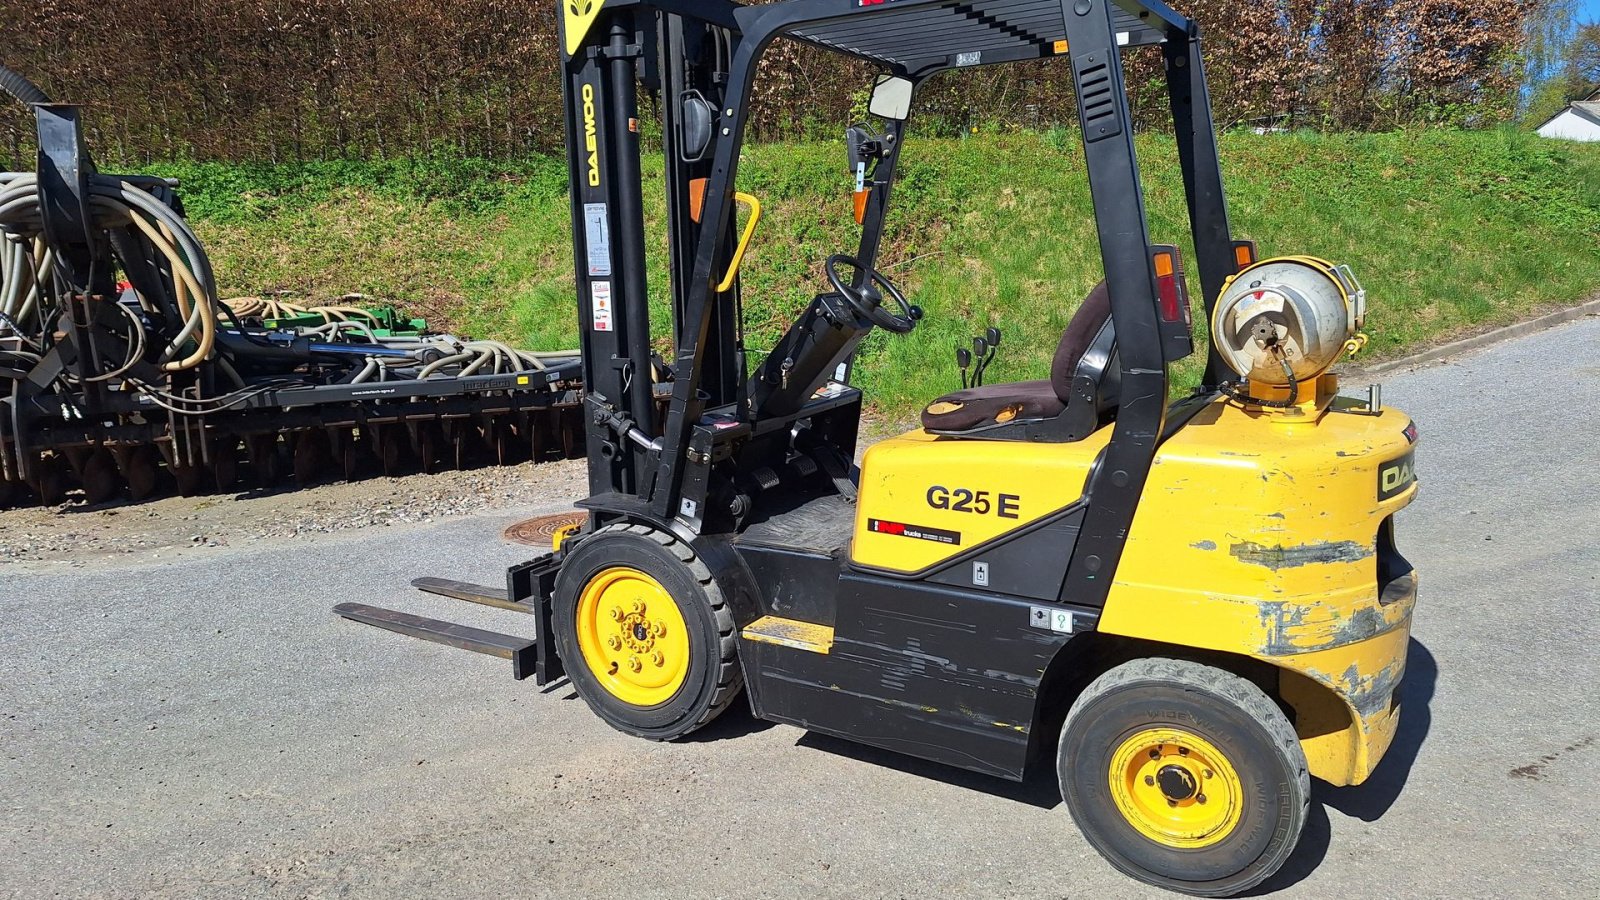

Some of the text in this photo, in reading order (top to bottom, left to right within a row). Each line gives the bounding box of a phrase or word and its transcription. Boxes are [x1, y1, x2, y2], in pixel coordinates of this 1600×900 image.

[582, 84, 600, 187] DAEWOO
[1382, 461, 1415, 492] DA
[926, 485, 1020, 519] G25 E
